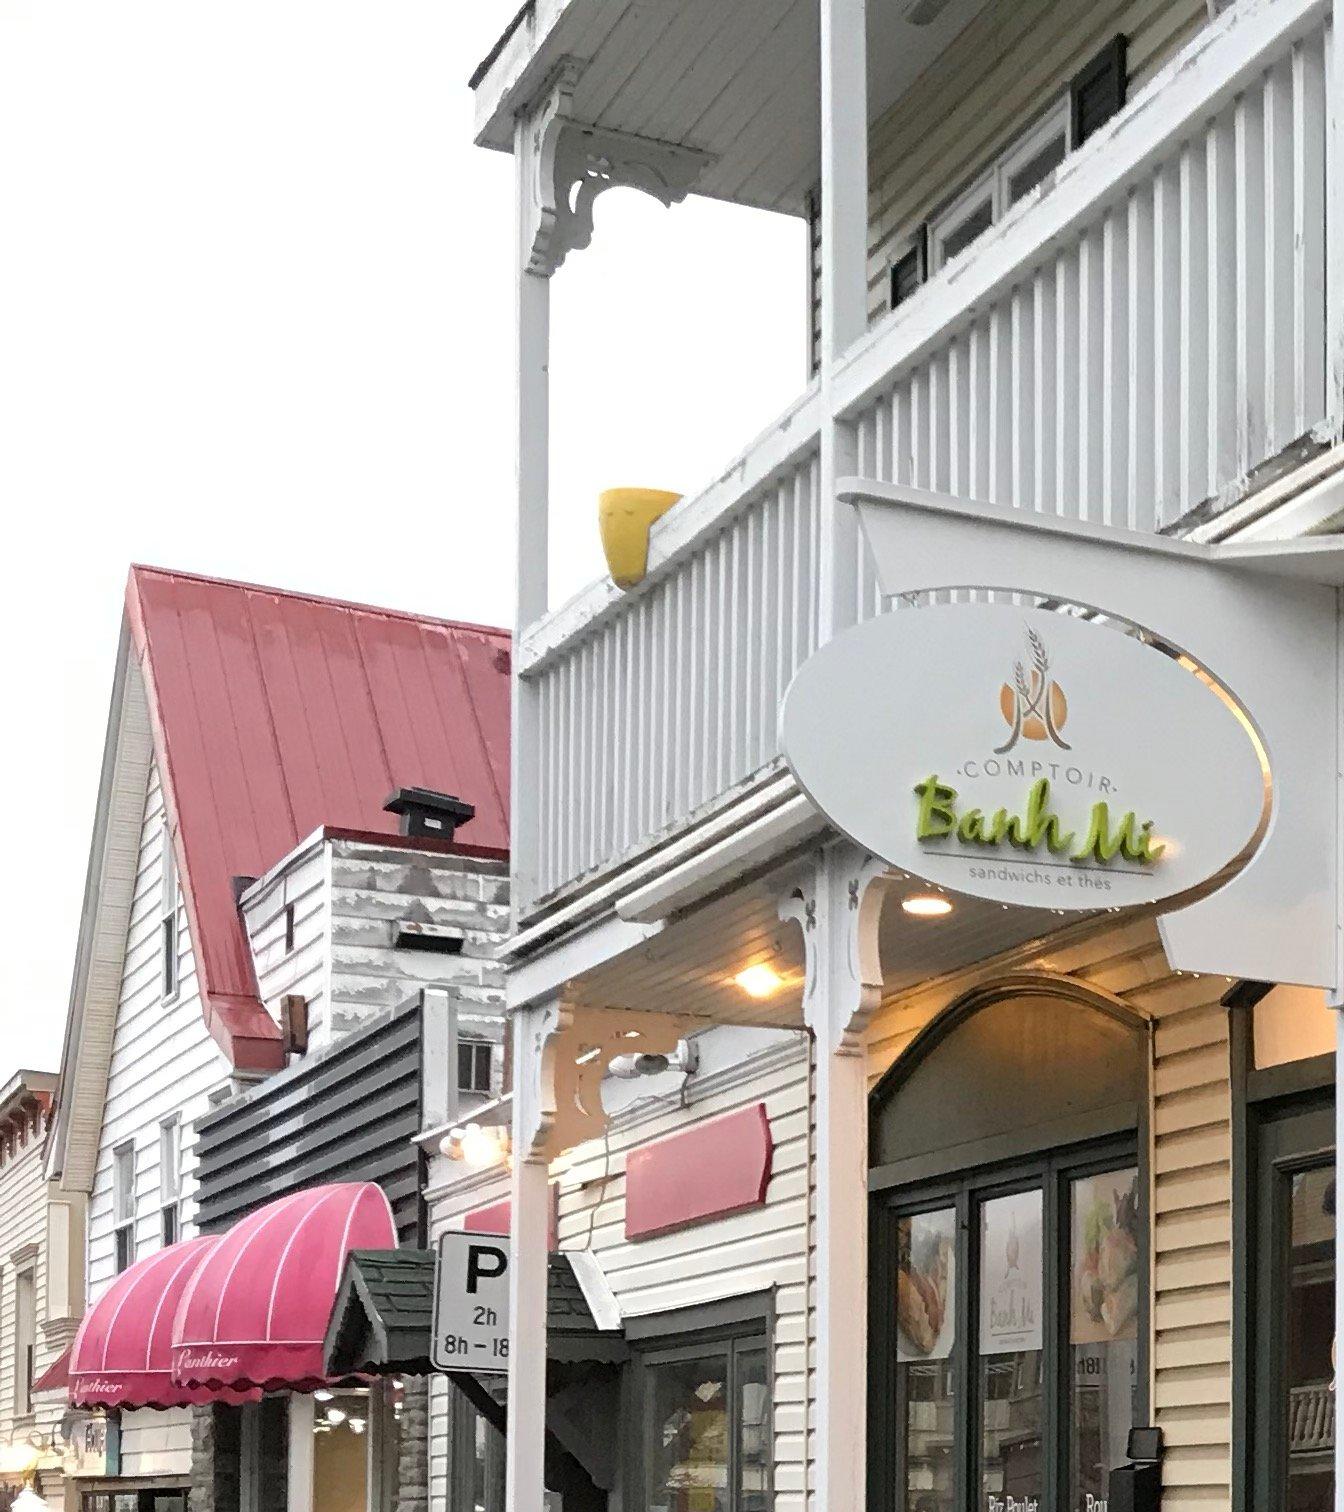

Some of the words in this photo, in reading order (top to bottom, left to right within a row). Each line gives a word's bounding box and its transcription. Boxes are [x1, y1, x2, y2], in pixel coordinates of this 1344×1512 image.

[913, 774, 1076, 857] Banh
[1070, 800, 1167, 866] Mi
[969, 864, 1051, 886] sandwichs
[1057, 872, 1073, 888] et
[466, 1245, 508, 1294] P
[473, 1305, 497, 1326] 2h
[444, 1334, 468, 1355] 8h
